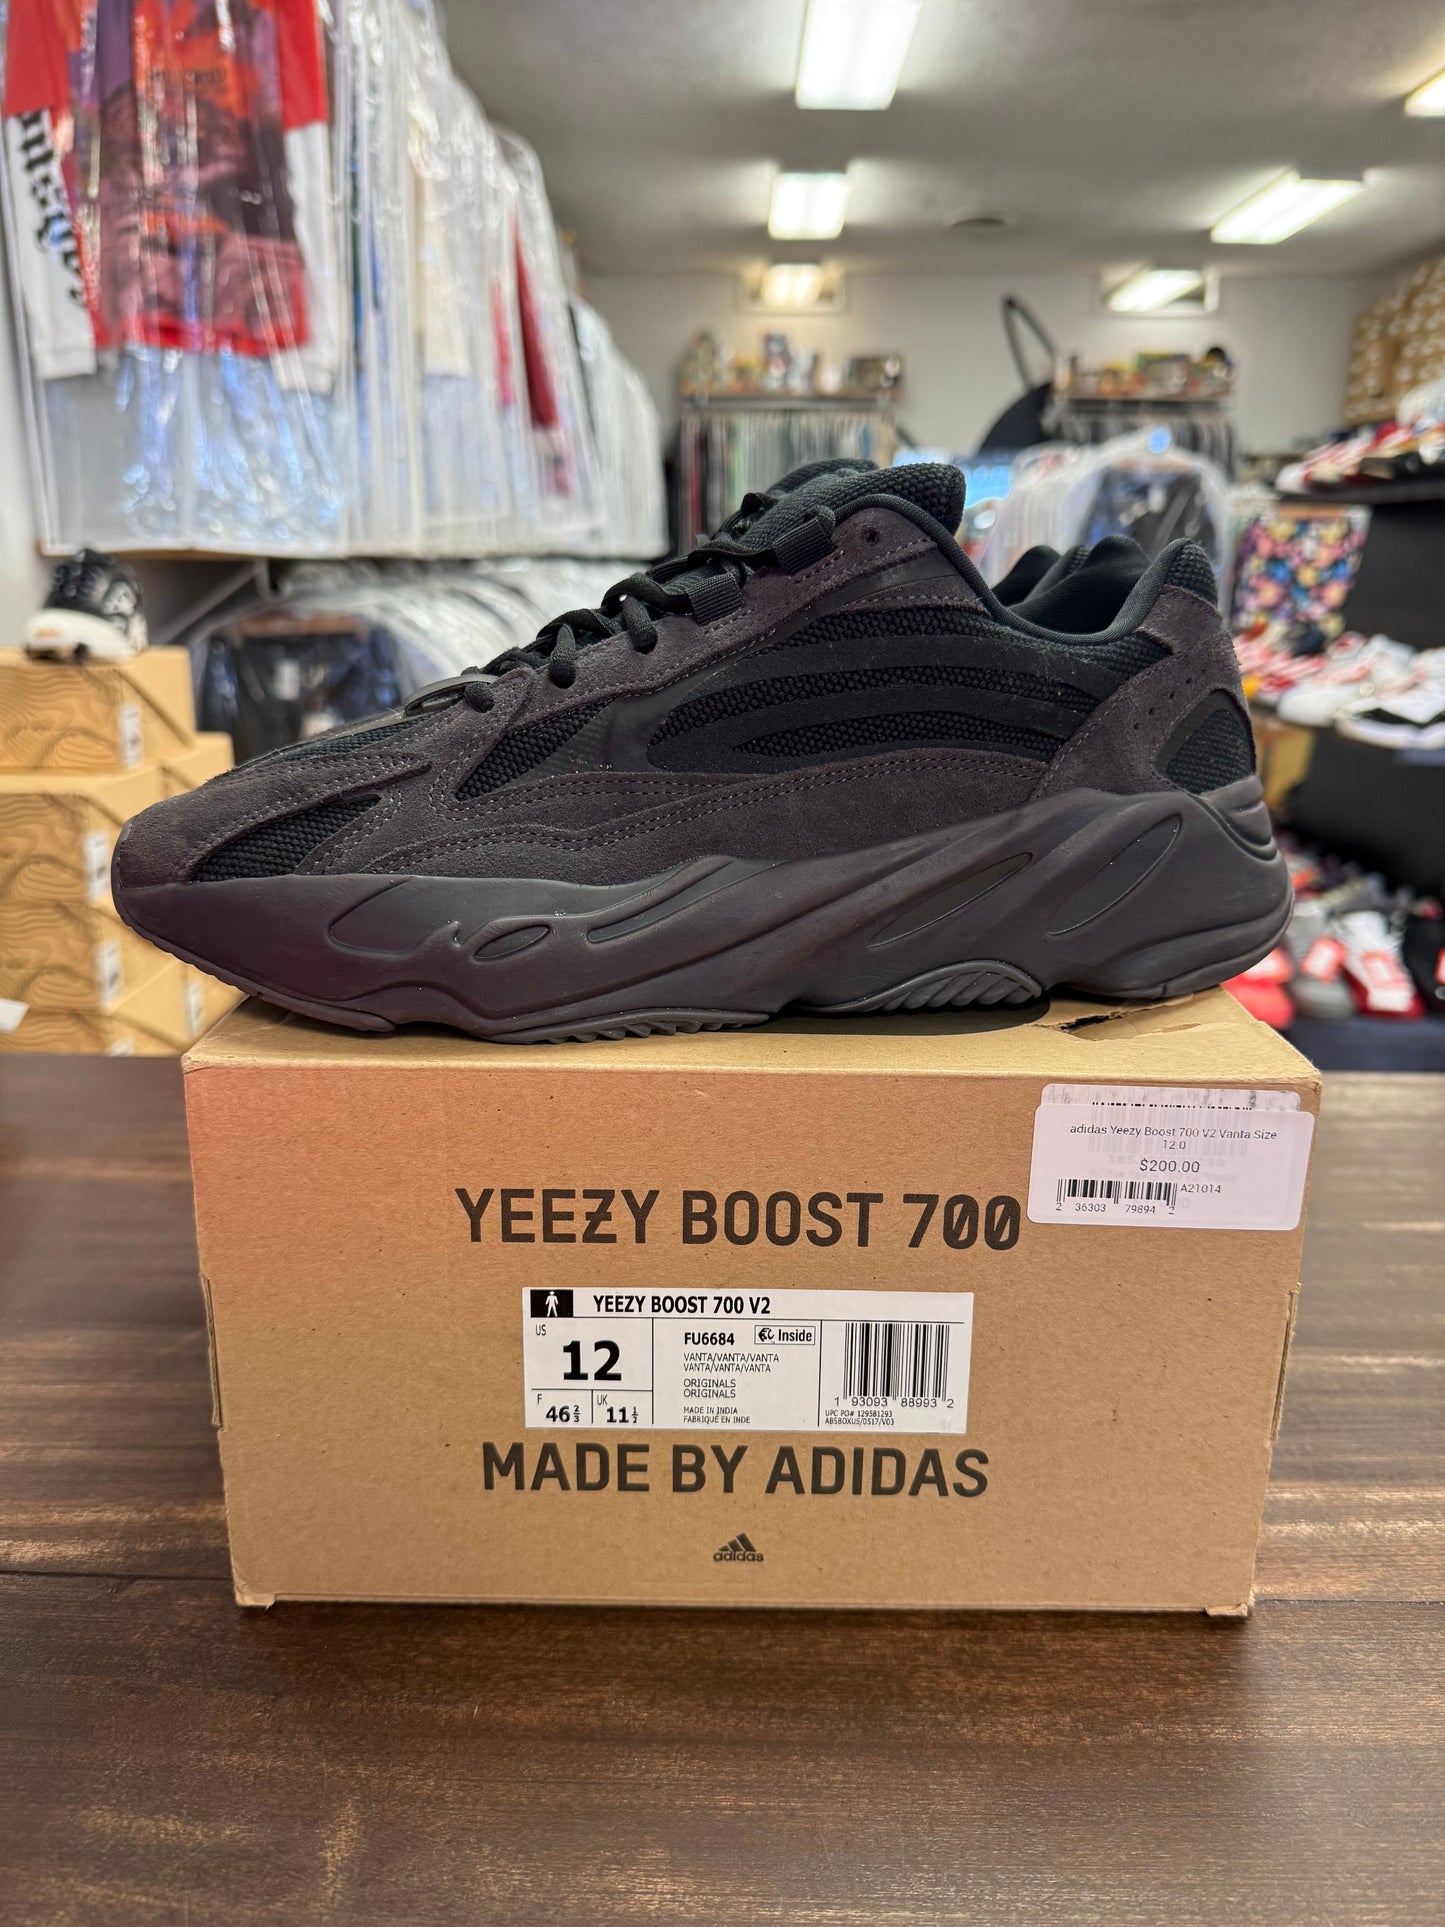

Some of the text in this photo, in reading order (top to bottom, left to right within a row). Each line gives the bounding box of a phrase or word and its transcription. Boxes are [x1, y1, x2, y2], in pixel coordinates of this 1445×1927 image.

[1070, 1124, 1278, 1140] adidas Yeezy Boost 700 V2 Vanta Size
[1163, 1140, 1187, 1150] 12.0
[1139, 1157, 1200, 1174] $200.00
[1180, 1183, 1222, 1195] A21014
[1074, 1202, 1107, 1213] 36303
[454, 1188, 1021, 1251] YEEZY BOOST 700
[593, 1295, 771, 1314] YEEZY BOOST 700 V2
[535, 1324, 547, 1337] US
[778, 1329, 813, 1342] Inside
[684, 1332, 736, 1346] FU6684
[562, 1340, 622, 1381] 12
[683, 1352, 780, 1363] VANTA/VANTA/VANTA
[683, 1362, 772, 1374] VANTA/VANTA/VANTA
[683, 1378, 737, 1388] ORIGINALS
[536, 1393, 543, 1405] F
[683, 1388, 737, 1399] ORIGINALS
[596, 1394, 609, 1406] UK
[851, 1396, 889, 1407] 93093
[900, 1397, 938, 1408] 88993
[946, 1398, 955, 1409] 2
[683, 1406, 739, 1416] MADE IN INDIA
[825, 1409, 839, 1417] UPC
[721, 1416, 731, 1424] EN
[733, 1416, 751, 1424] INDE
[482, 1441, 989, 1498] MADE BY ADIDAS
[713, 1549, 764, 1562] adidas
